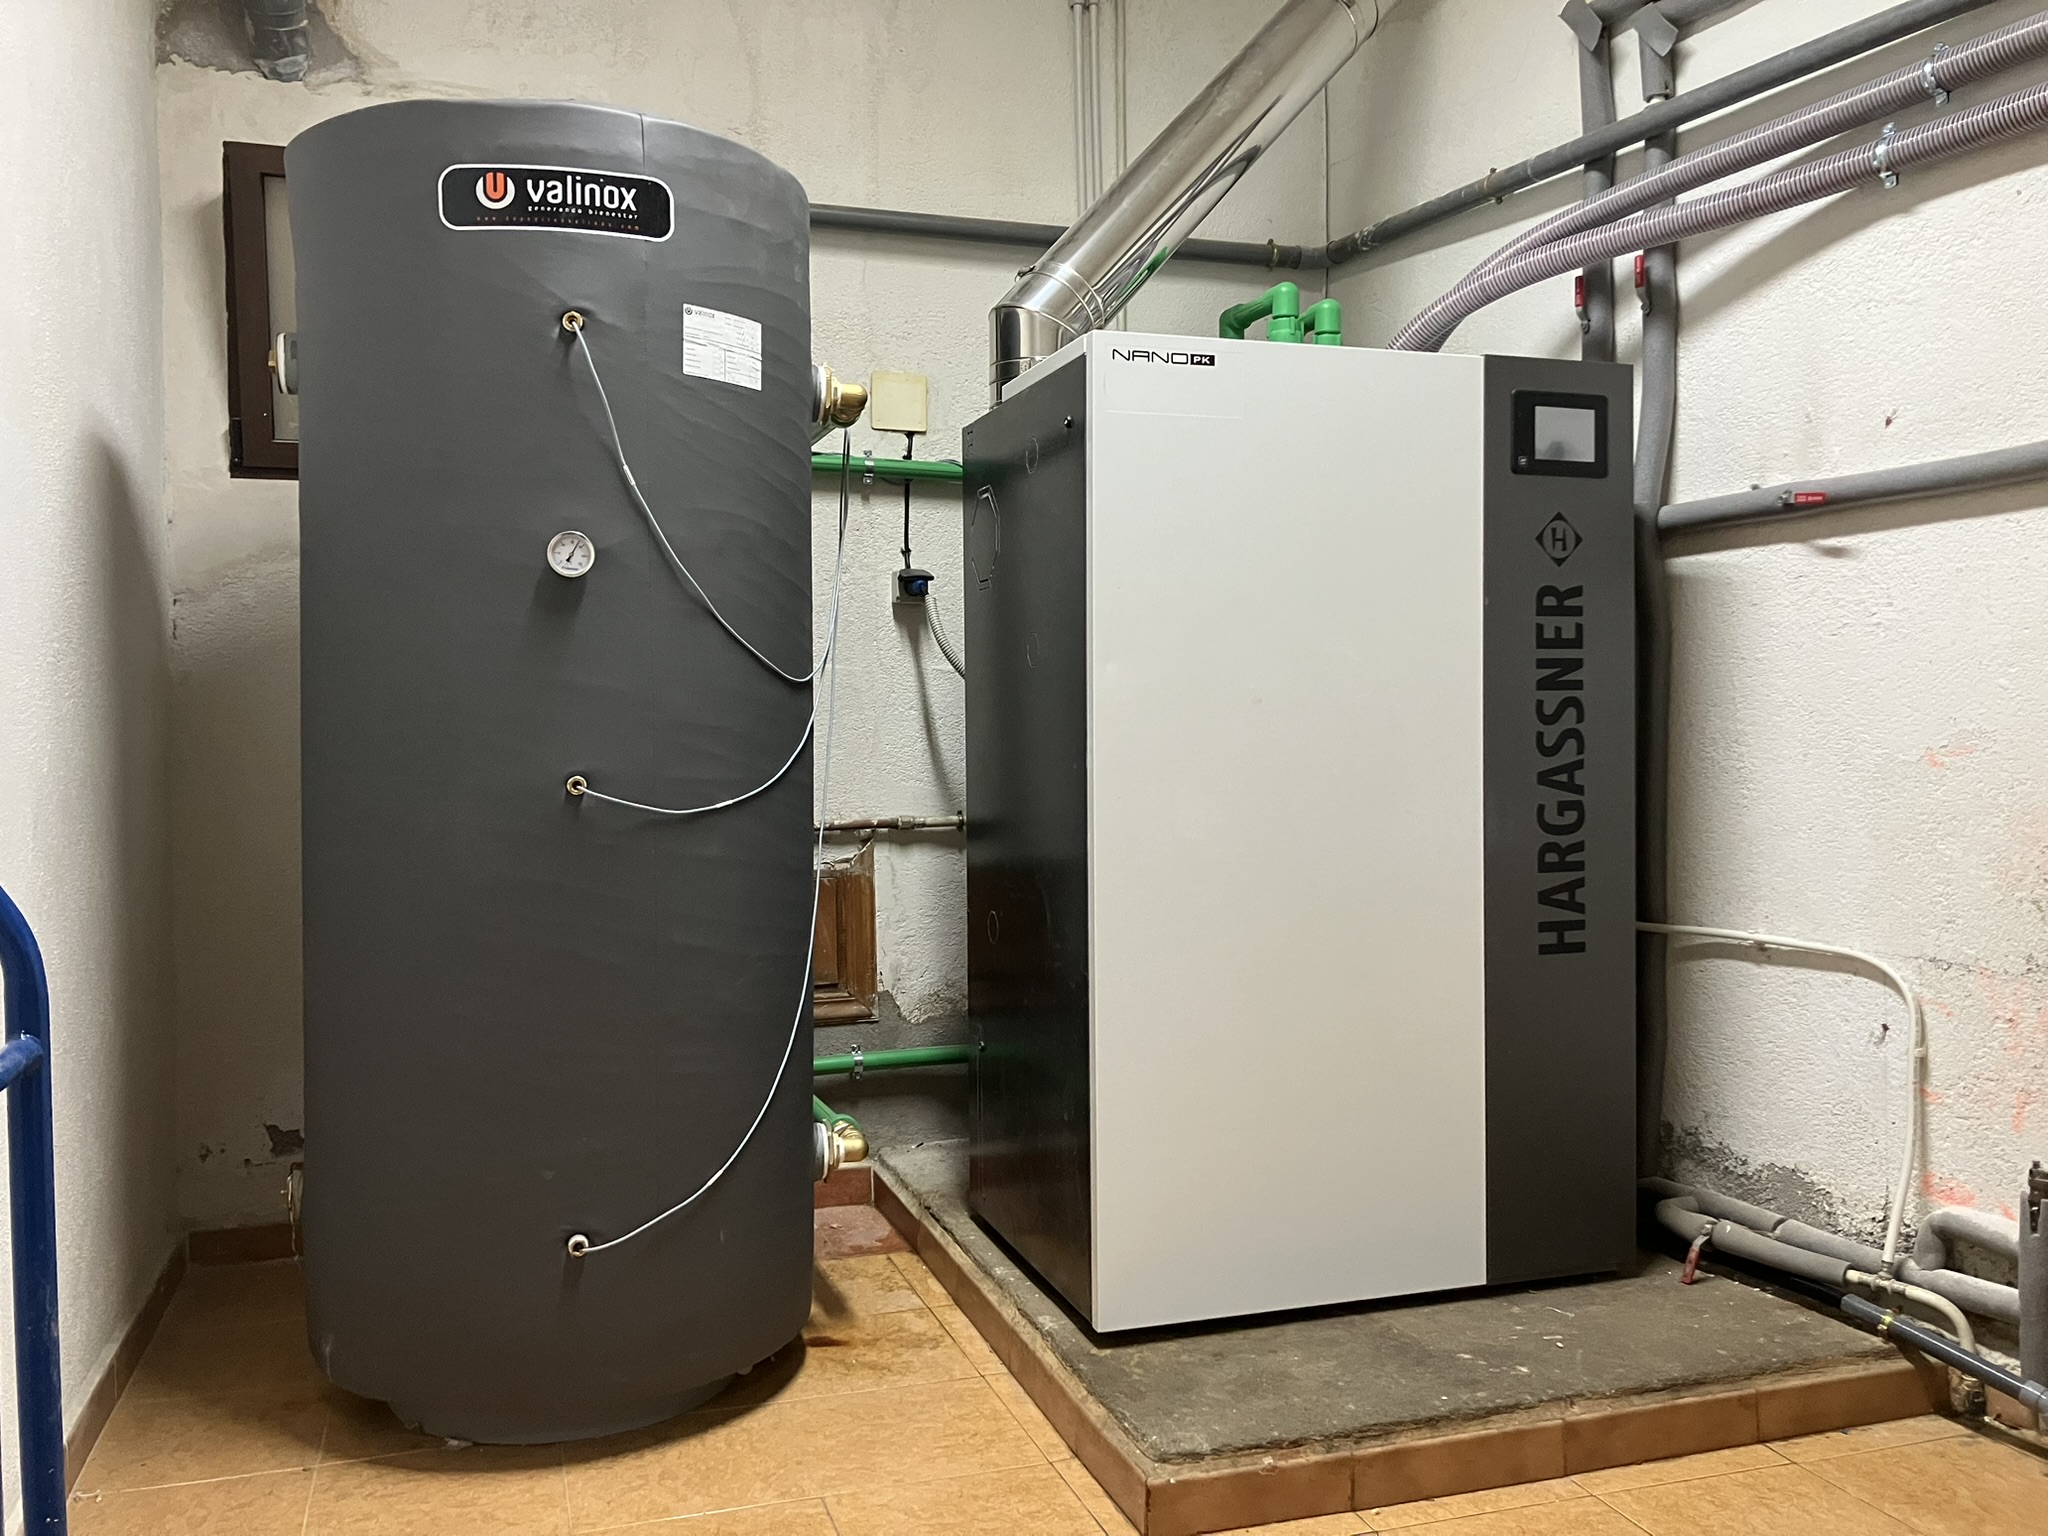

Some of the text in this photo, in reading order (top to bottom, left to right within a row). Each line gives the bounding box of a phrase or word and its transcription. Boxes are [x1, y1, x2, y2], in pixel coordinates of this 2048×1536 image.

[526, 174, 637, 212] valinox
[527, 205, 638, 219] generando bienestar
[1112, 348, 1212, 365] NANO PK
[1535, 584, 1587, 956] HARGASSNER
